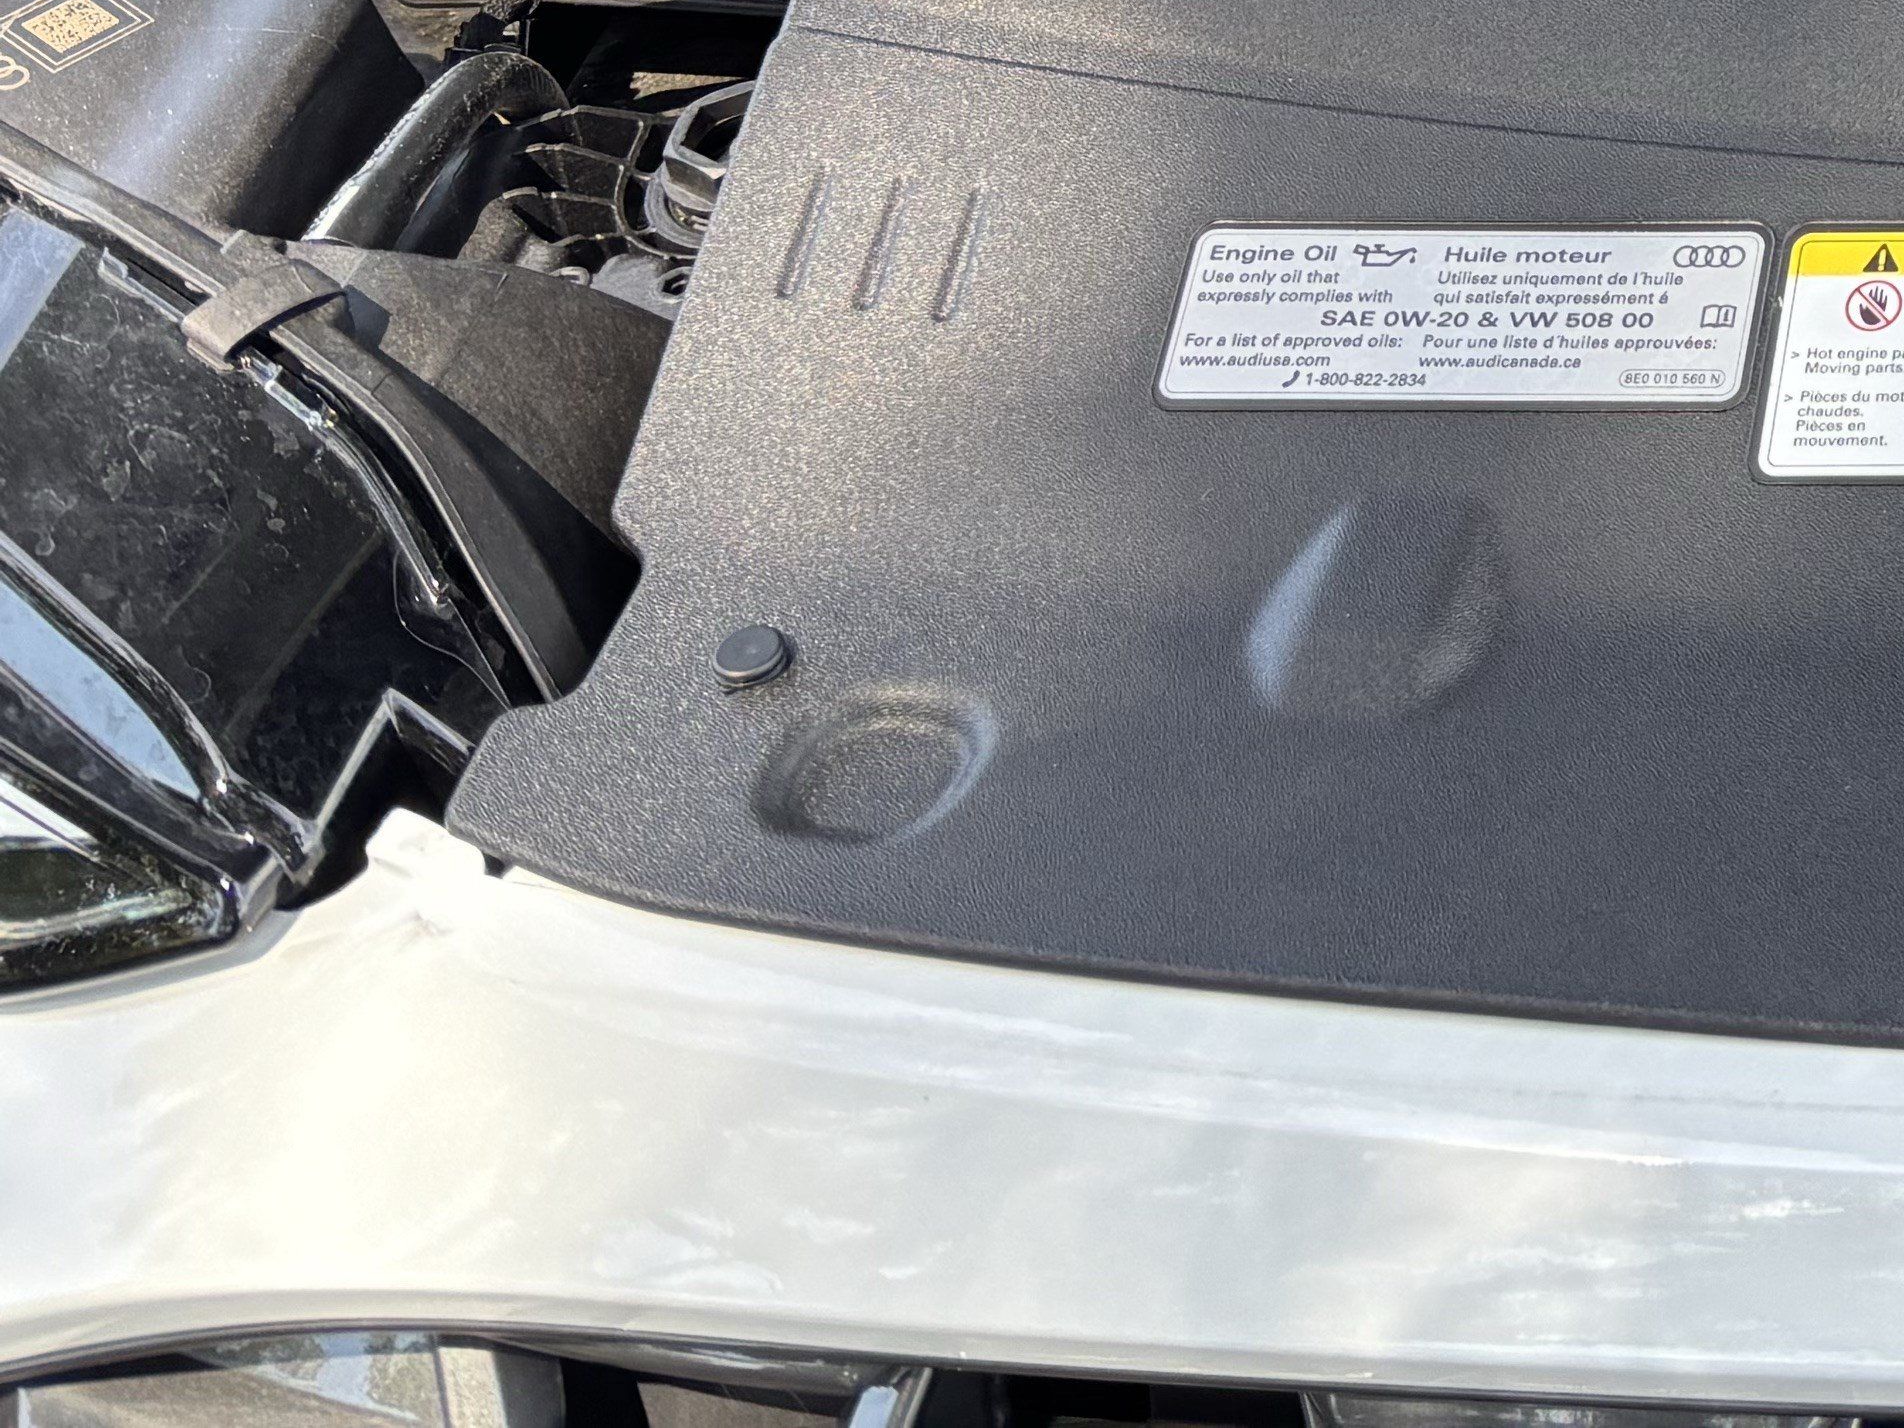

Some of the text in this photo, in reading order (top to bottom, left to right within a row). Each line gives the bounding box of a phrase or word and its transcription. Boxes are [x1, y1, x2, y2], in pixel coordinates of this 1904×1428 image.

[1209, 245, 1337, 264] Engine Oil
[1444, 247, 1612, 263] Huile moteur
[1202, 270, 1340, 286] Use only oil that
[1438, 271, 1497, 285] Utilisez
[1502, 273, 1603, 287] uniquement
[1607, 273, 1627, 285] de
[1197, 290, 1393, 306] expressly complies with
[1434, 291, 1461, 306] qui
[1465, 291, 1531, 304] satisfait
[1535, 292, 1654, 306] expressément
[1320, 310, 1653, 328] SAE 0W-20 & VW 508 00
[1185, 333, 1402, 350] For a list of approved oils:
[1423, 335, 1463, 348] Pour
[1467, 337, 1498, 348] une
[1504, 335, 1537, 348] liste
[1614, 336, 1717, 353] approuvées:
[1179, 353, 1330, 367] www.audiusa.com
[1807, 348, 1832, 359] Hot
[1838, 348, 1887, 361] engine
[1419, 356, 1581, 368] www.audicanada.ca
[1805, 362, 1860, 375] Moving
[1307, 373, 1426, 386] 1-800-822-2834
[1710, 374, 1720, 383] N
[1852, 391, 1870, 402] du
[1798, 406, 1864, 417] chaudes.
[1848, 422, 1866, 431] en
[1793, 435, 1887, 446] mouvement.
